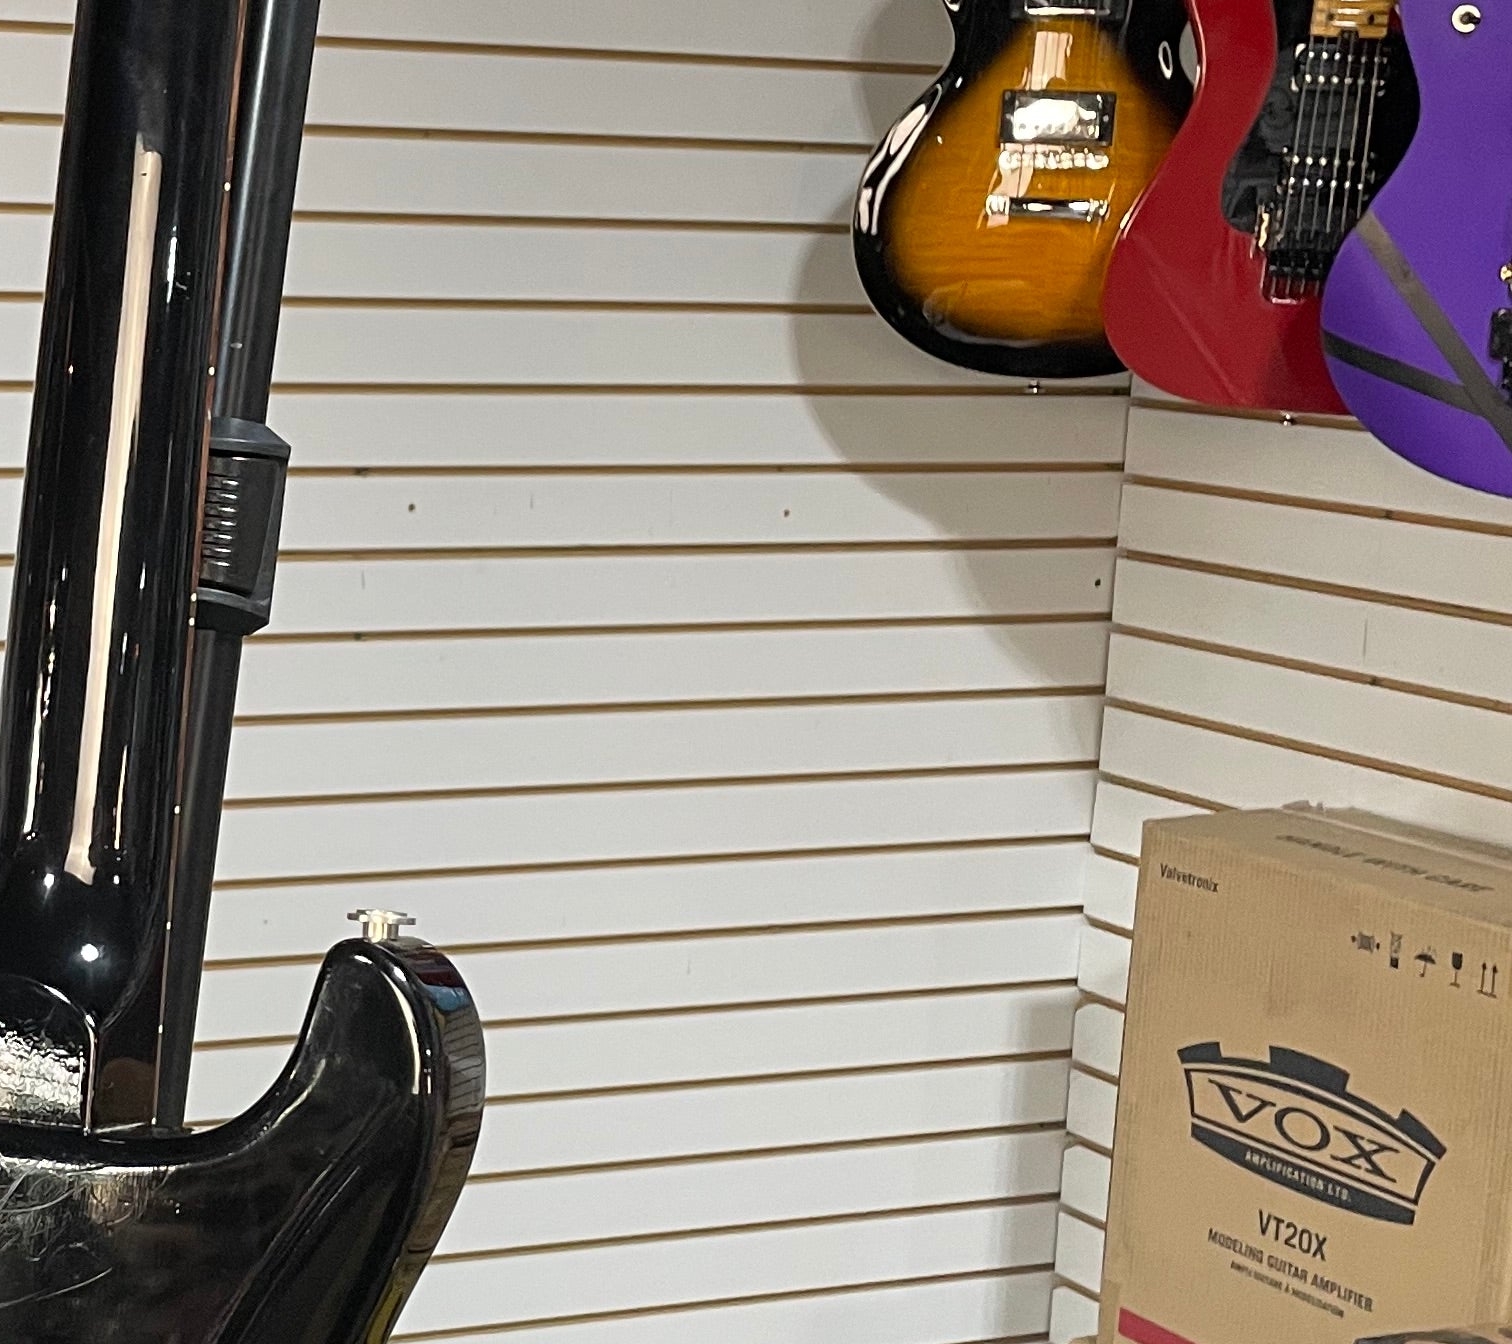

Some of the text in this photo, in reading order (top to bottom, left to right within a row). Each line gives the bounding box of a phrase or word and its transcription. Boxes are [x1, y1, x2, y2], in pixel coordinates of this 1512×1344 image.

[1208, 1078, 1400, 1183] VOX
[1245, 1149, 1324, 1194] AMPLIFICATION
[1258, 1208, 1328, 1261] VT20X
[1208, 1228, 1264, 1264] MODELING
[1267, 1253, 1308, 1284] GUITAR
[1311, 1273, 1373, 1312] AMPLIFIER
